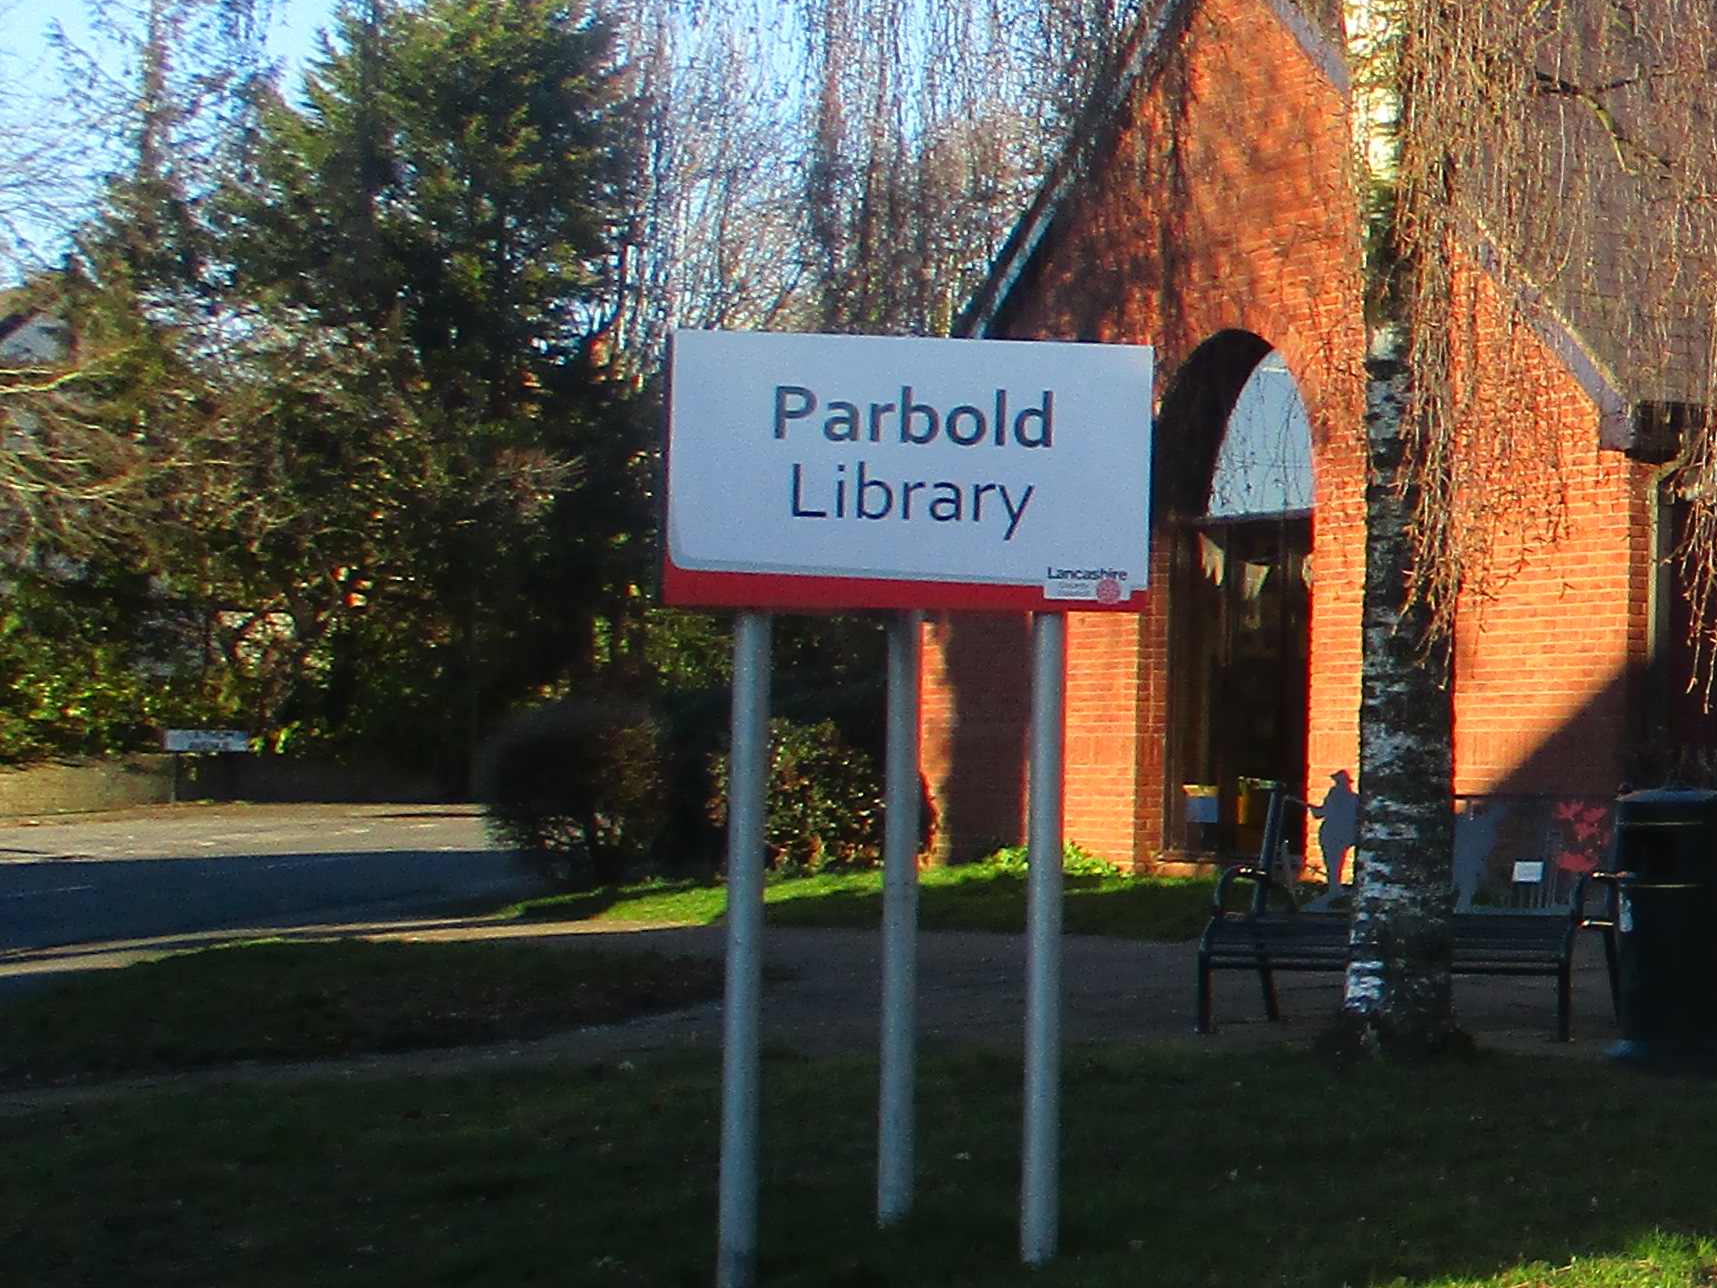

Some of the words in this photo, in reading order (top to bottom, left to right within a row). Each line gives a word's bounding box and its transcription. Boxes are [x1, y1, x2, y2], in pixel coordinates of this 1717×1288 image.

[773, 386, 1054, 448] Parbold
[791, 462, 1035, 540] Library
[1047, 567, 1128, 581] Lancashire
